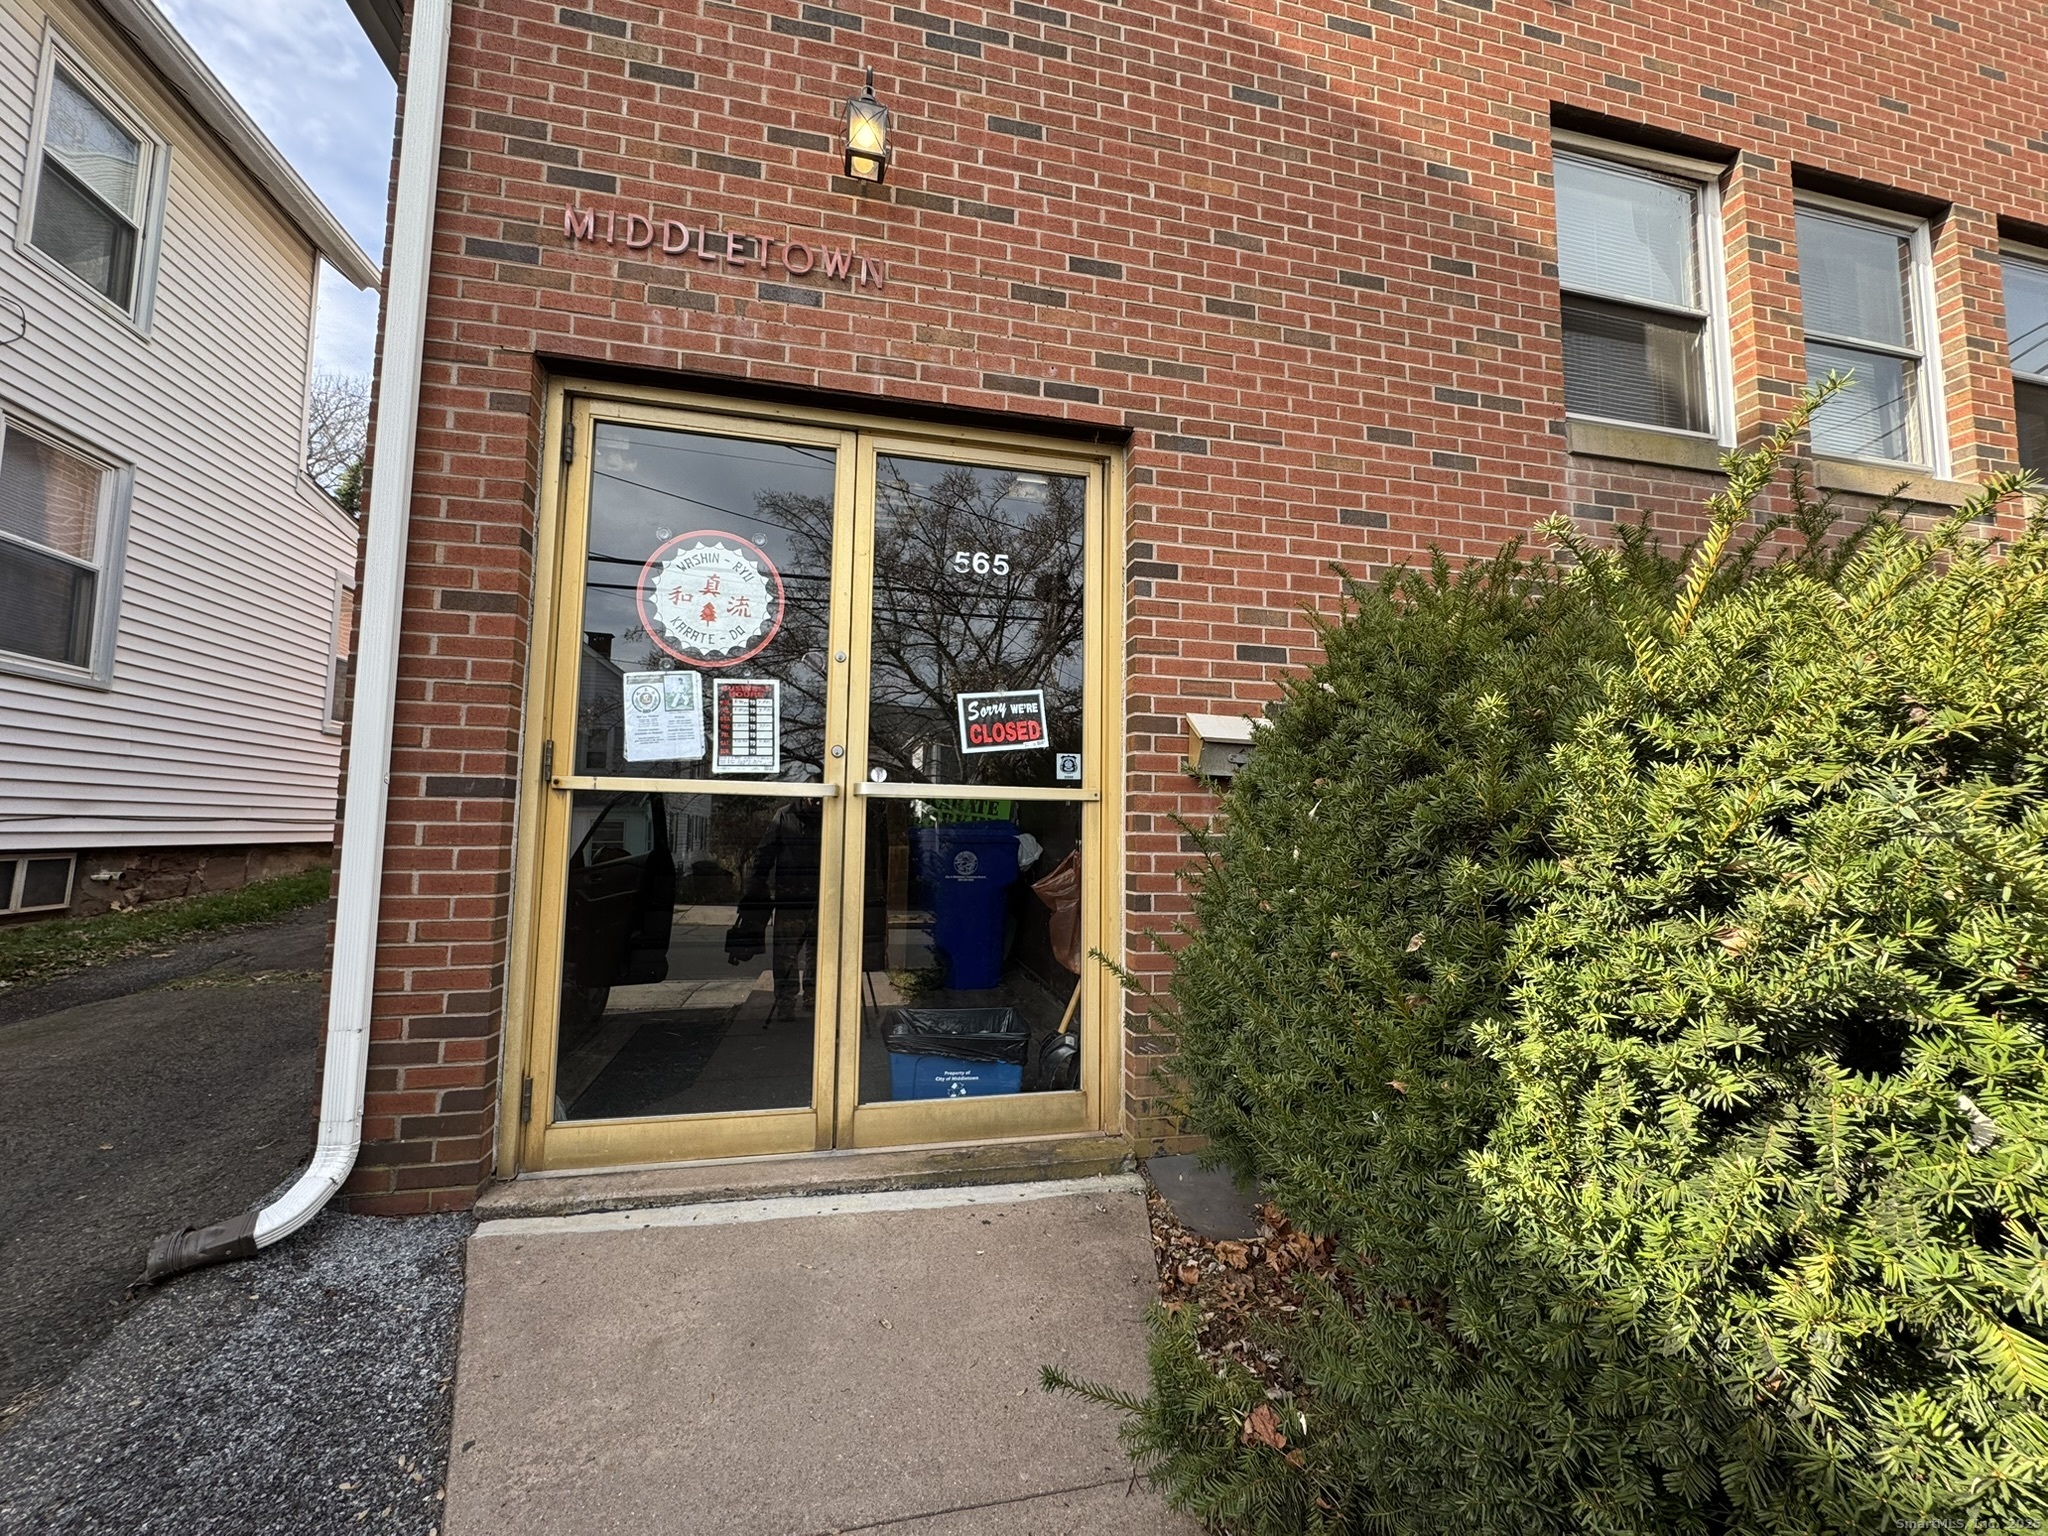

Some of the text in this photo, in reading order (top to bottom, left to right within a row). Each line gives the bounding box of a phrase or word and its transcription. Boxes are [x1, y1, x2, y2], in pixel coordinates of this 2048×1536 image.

[564, 203, 885, 290] MIDDLETOWN
[676, 553, 720, 572] WASHIN
[732, 561, 754, 583] RYU
[953, 551, 1010, 576] 565
[670, 616, 715, 645] KARATE
[967, 701, 1038, 721] Sorry WE'RE
[970, 720, 1041, 744] CLOSED
